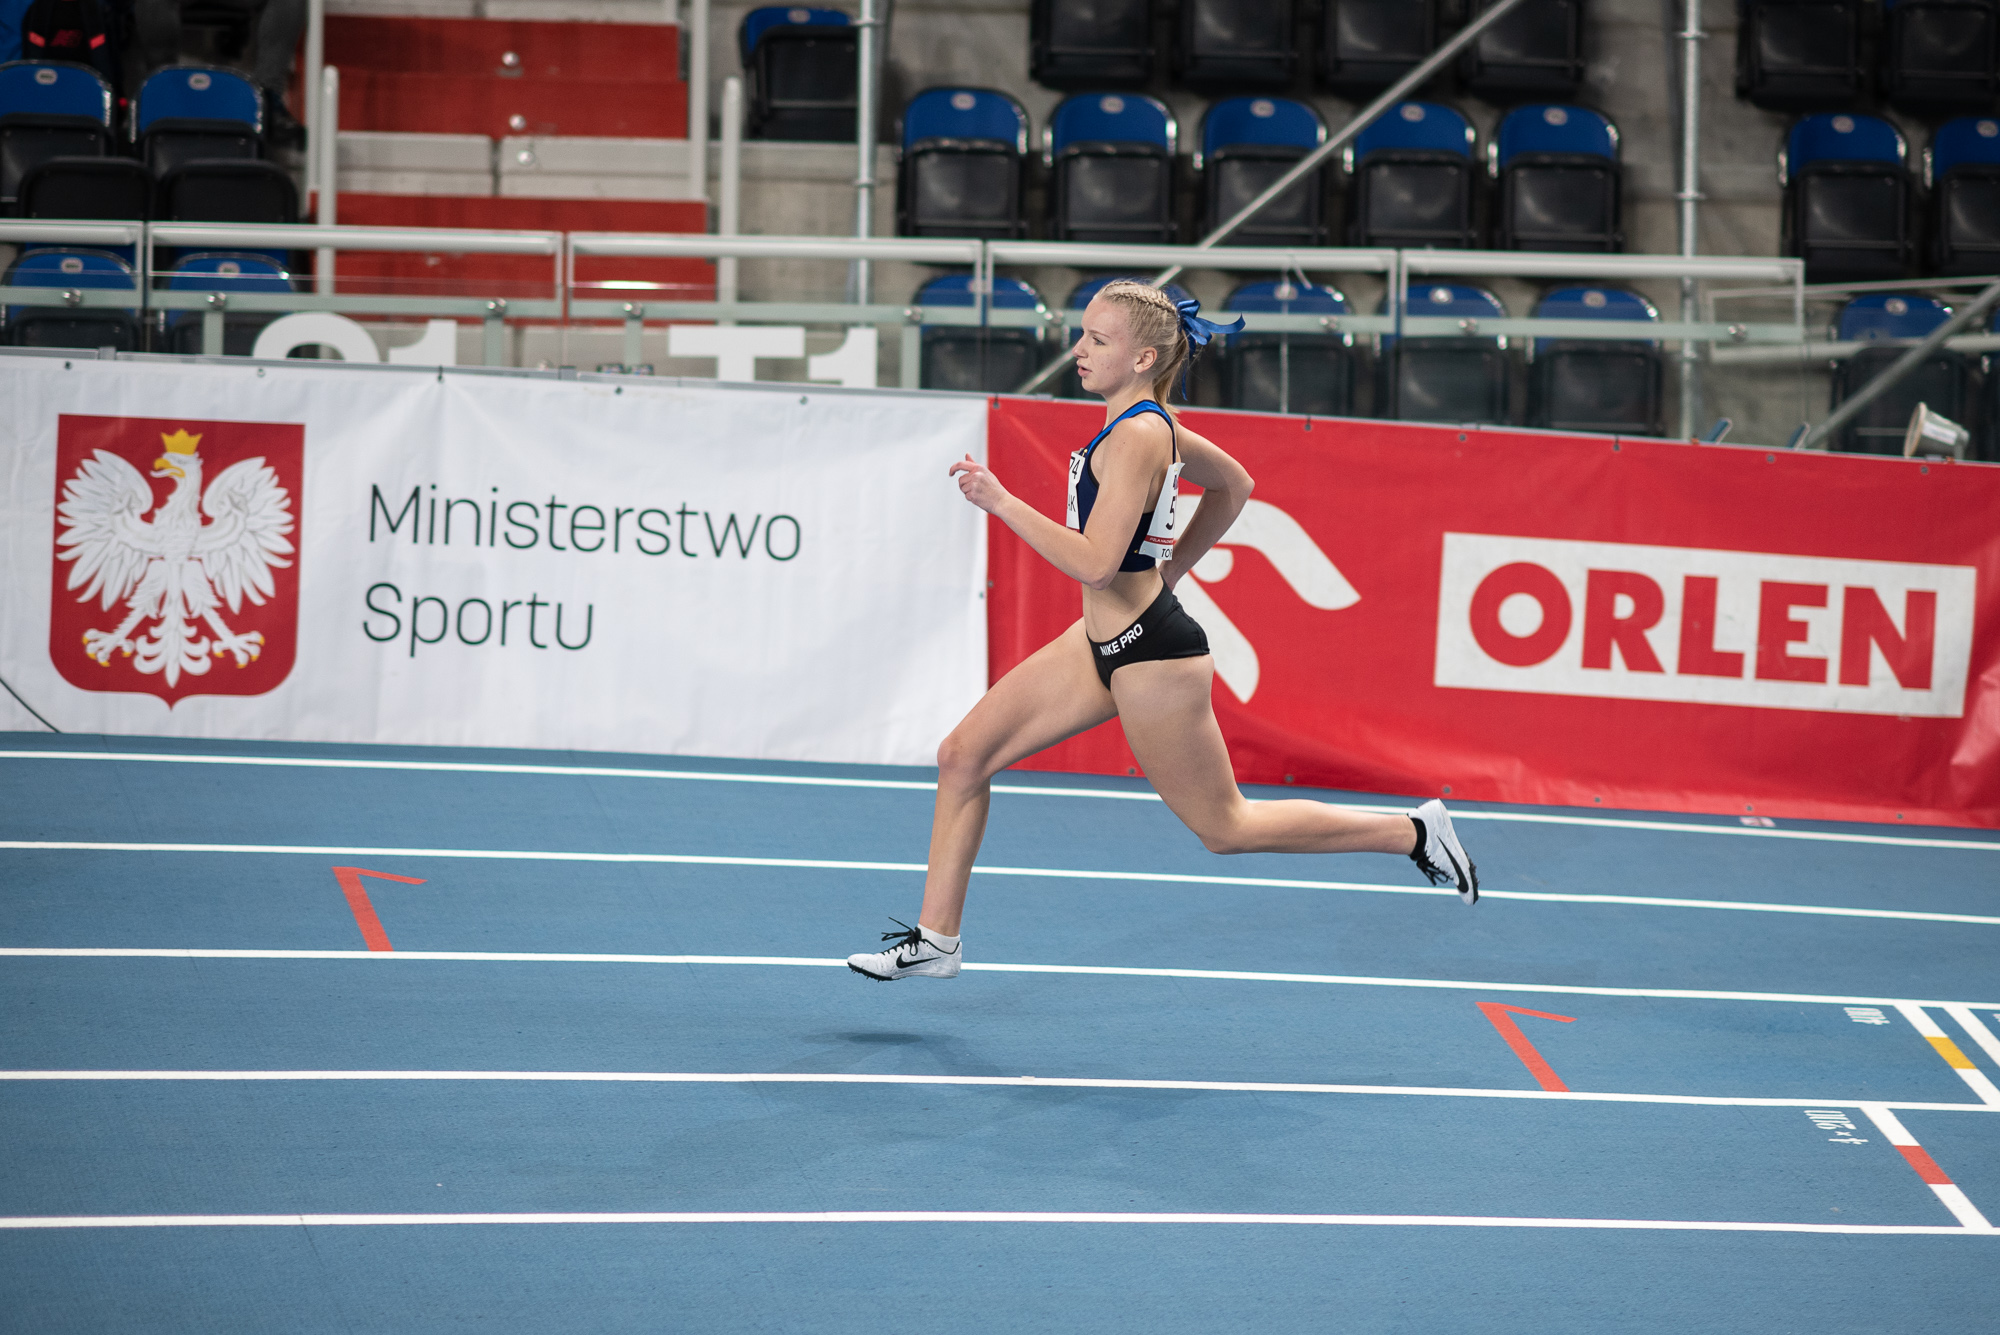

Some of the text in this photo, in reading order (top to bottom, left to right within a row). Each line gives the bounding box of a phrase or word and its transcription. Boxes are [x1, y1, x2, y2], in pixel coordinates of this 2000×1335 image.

[369, 483, 801, 561] Ministerstwo
[363, 582, 593, 657] Sportu
[1099, 623, 1144, 656] NIKE PRO
[1469, 561, 1937, 691] ORLEN
